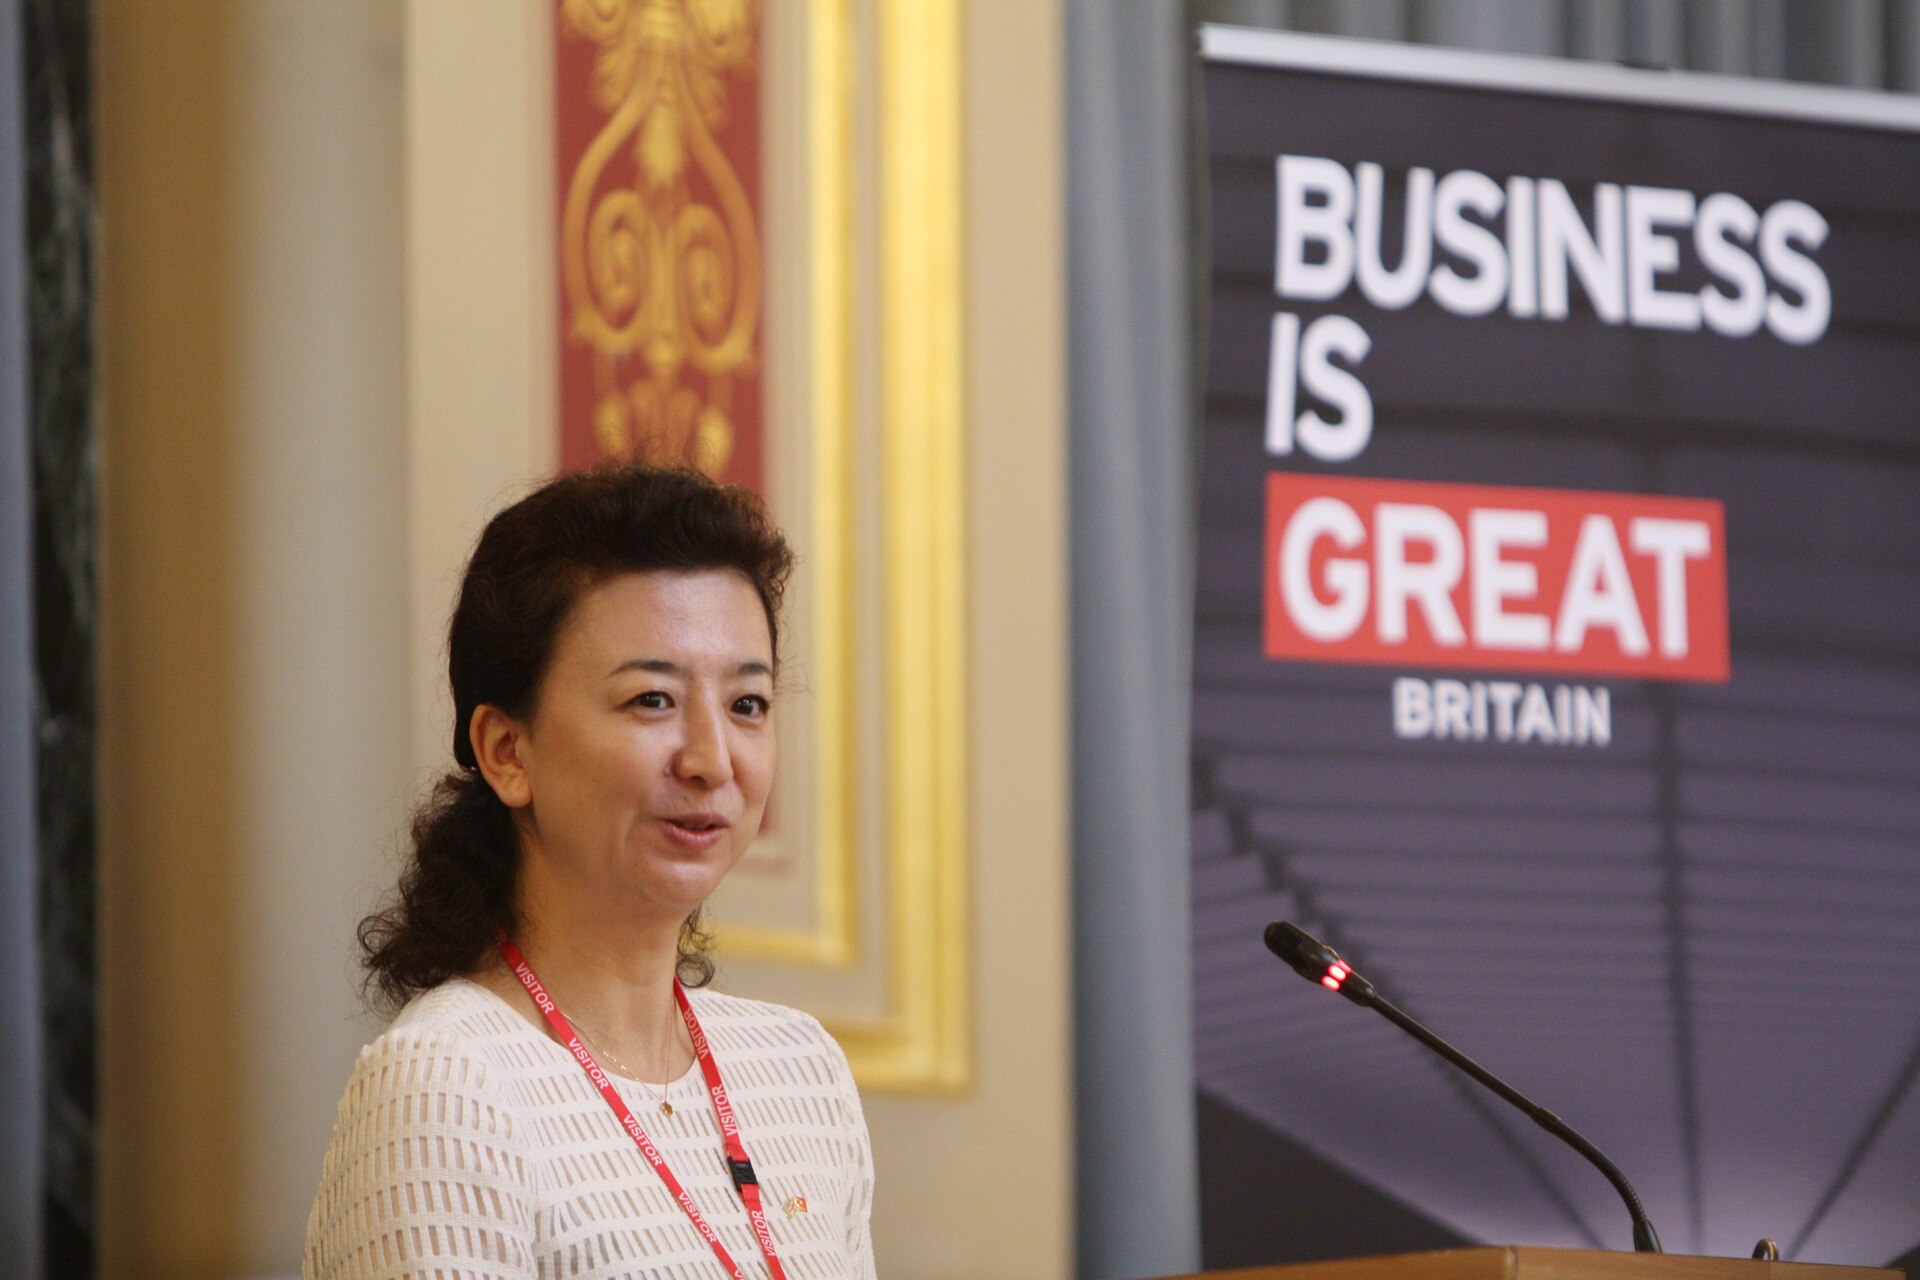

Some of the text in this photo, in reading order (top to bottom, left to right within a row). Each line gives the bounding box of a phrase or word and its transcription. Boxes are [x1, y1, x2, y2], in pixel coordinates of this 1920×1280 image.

[1275, 154, 1831, 345] BUSINESS
[1265, 311, 1373, 462] IS
[1279, 497, 1711, 659] GREAT
[1393, 677, 1611, 746] BRITAIN
[515, 962, 554, 1014] VISITOR
[684, 1008, 709, 1060] VISITOR
[568, 1037, 609, 1089] VISITOR
[711, 1084, 738, 1136] VISITOR
[623, 1114, 662, 1166] VISITOR
[679, 1192, 717, 1243] VISITOR
[751, 1210, 776, 1257] VISITOR
